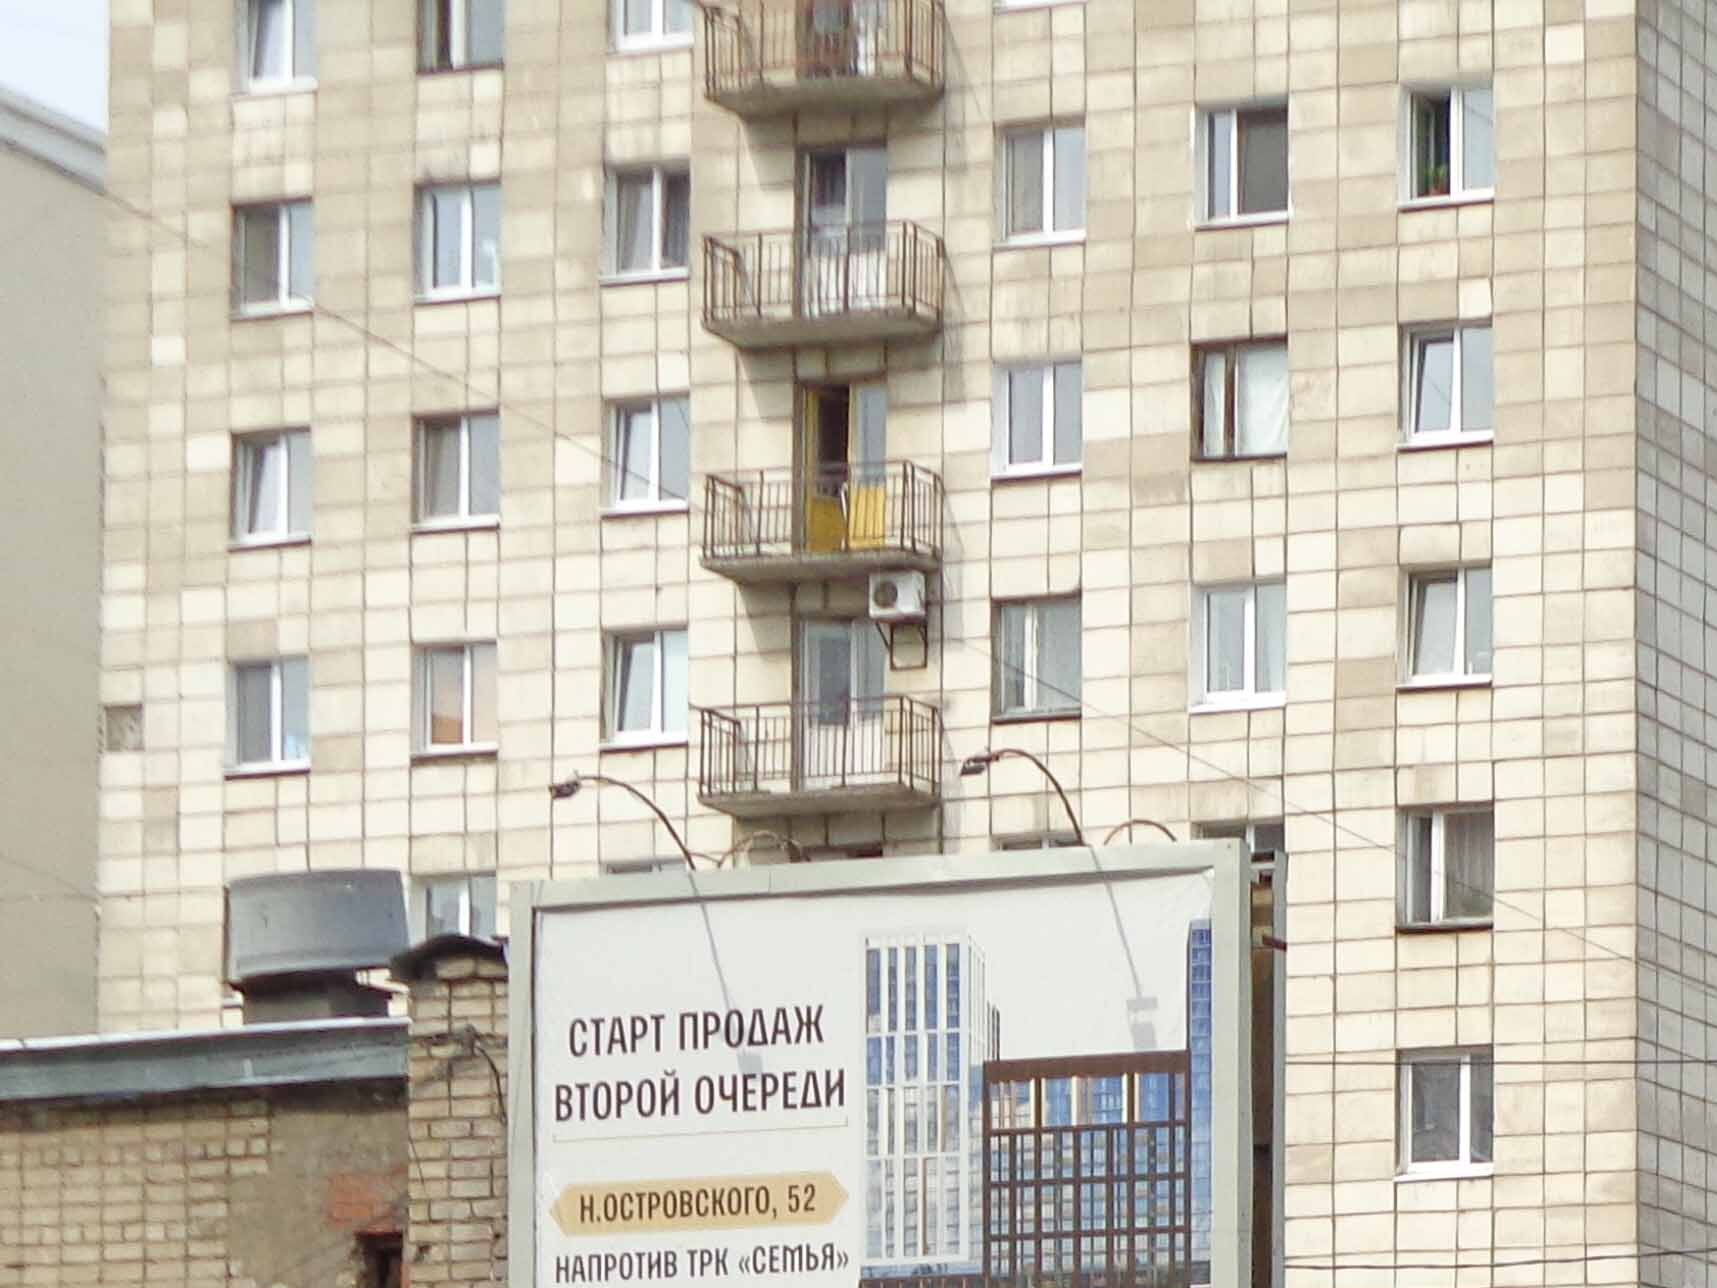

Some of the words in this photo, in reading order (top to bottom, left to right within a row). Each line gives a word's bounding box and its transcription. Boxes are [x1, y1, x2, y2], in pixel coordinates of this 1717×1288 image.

[568, 1013, 666, 1058] СТАРТ
[678, 1004, 824, 1051] ПРОДАЖ
[554, 1068, 680, 1122] ВТОРОЙ
[694, 1067, 846, 1115] ОЧЕРЕДИ
[579, 1185, 778, 1224] Н.ОСТРОВСКОГО,
[787, 1183, 816, 1213] 52
[555, 1250, 678, 1284] НАПРОТИВ
[687, 1248, 729, 1277] ТРК
[738, 1242, 849, 1275] «СЕМЬЯ»
